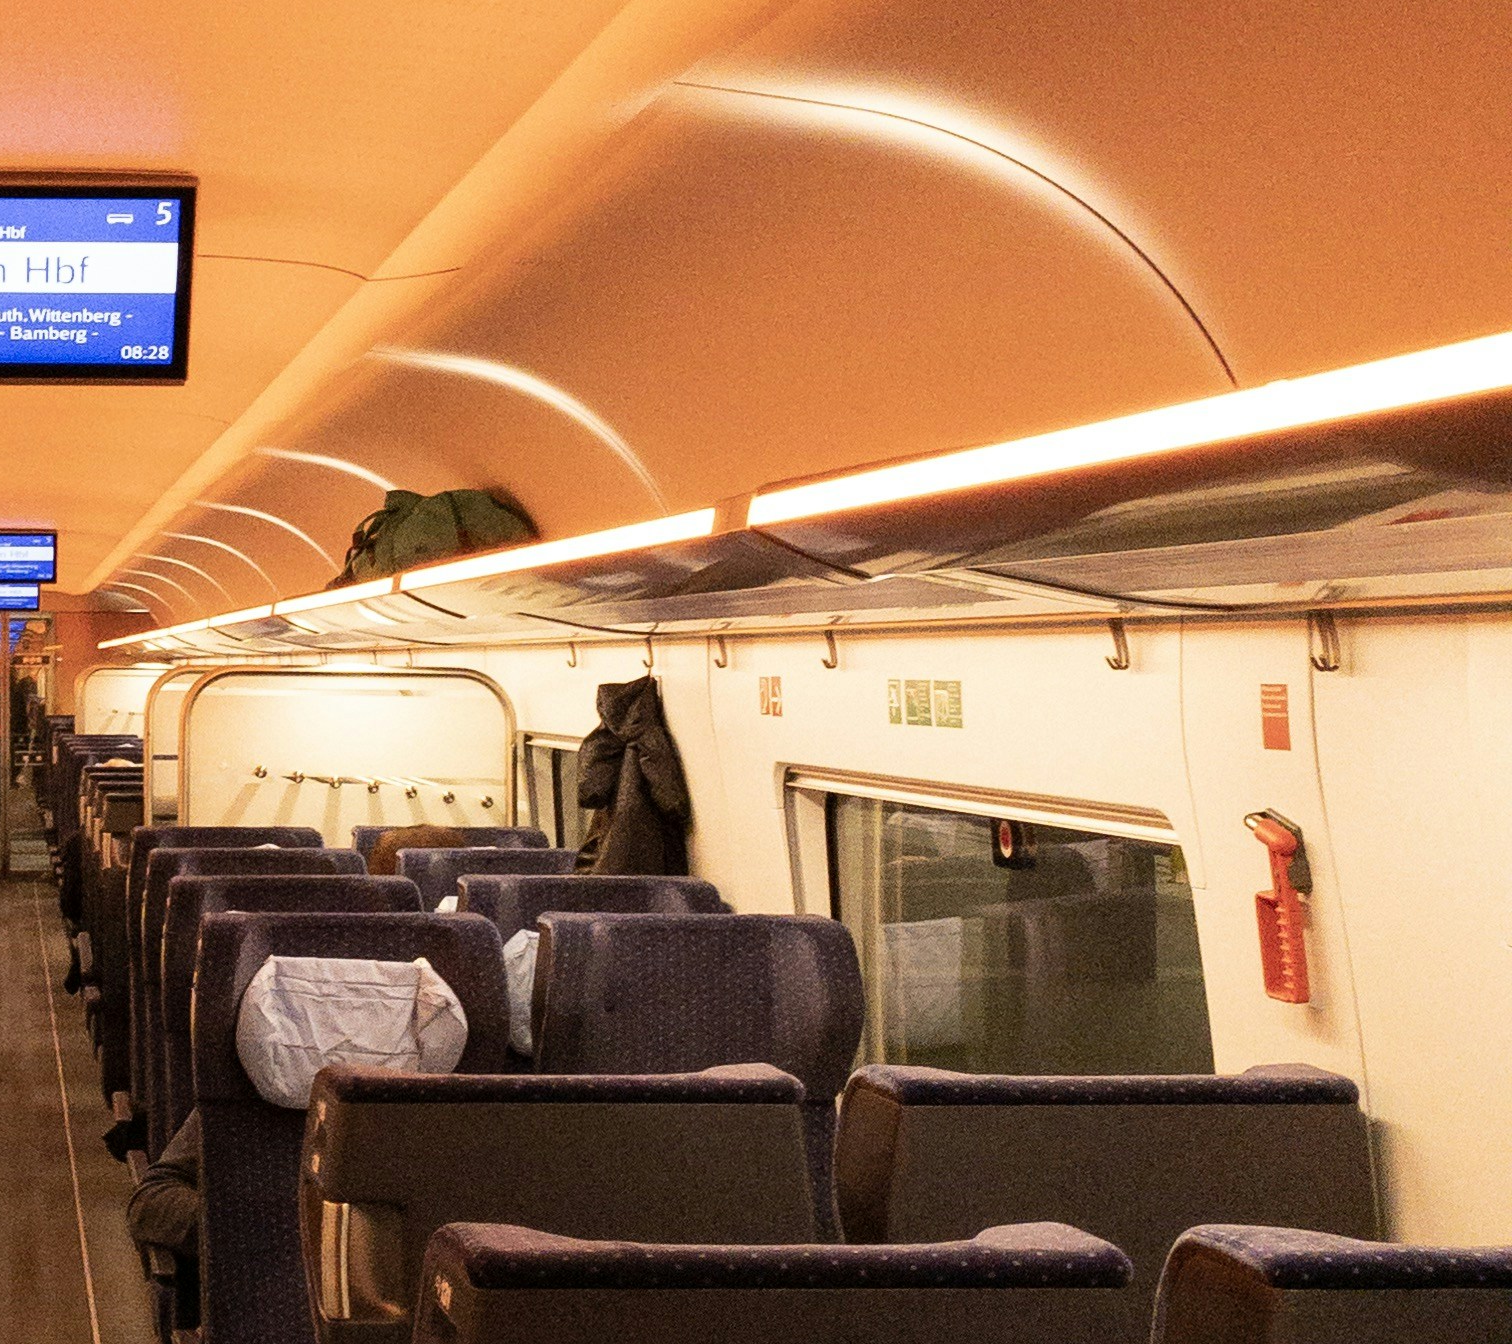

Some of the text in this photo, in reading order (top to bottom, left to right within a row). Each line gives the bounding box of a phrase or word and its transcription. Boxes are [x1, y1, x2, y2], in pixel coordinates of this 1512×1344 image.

[155, 201, 172, 226] 5
[26, 256, 89, 284] Hbf
[10, 325, 88, 344] Bamberg
[120, 345, 170, 360] 08:28
